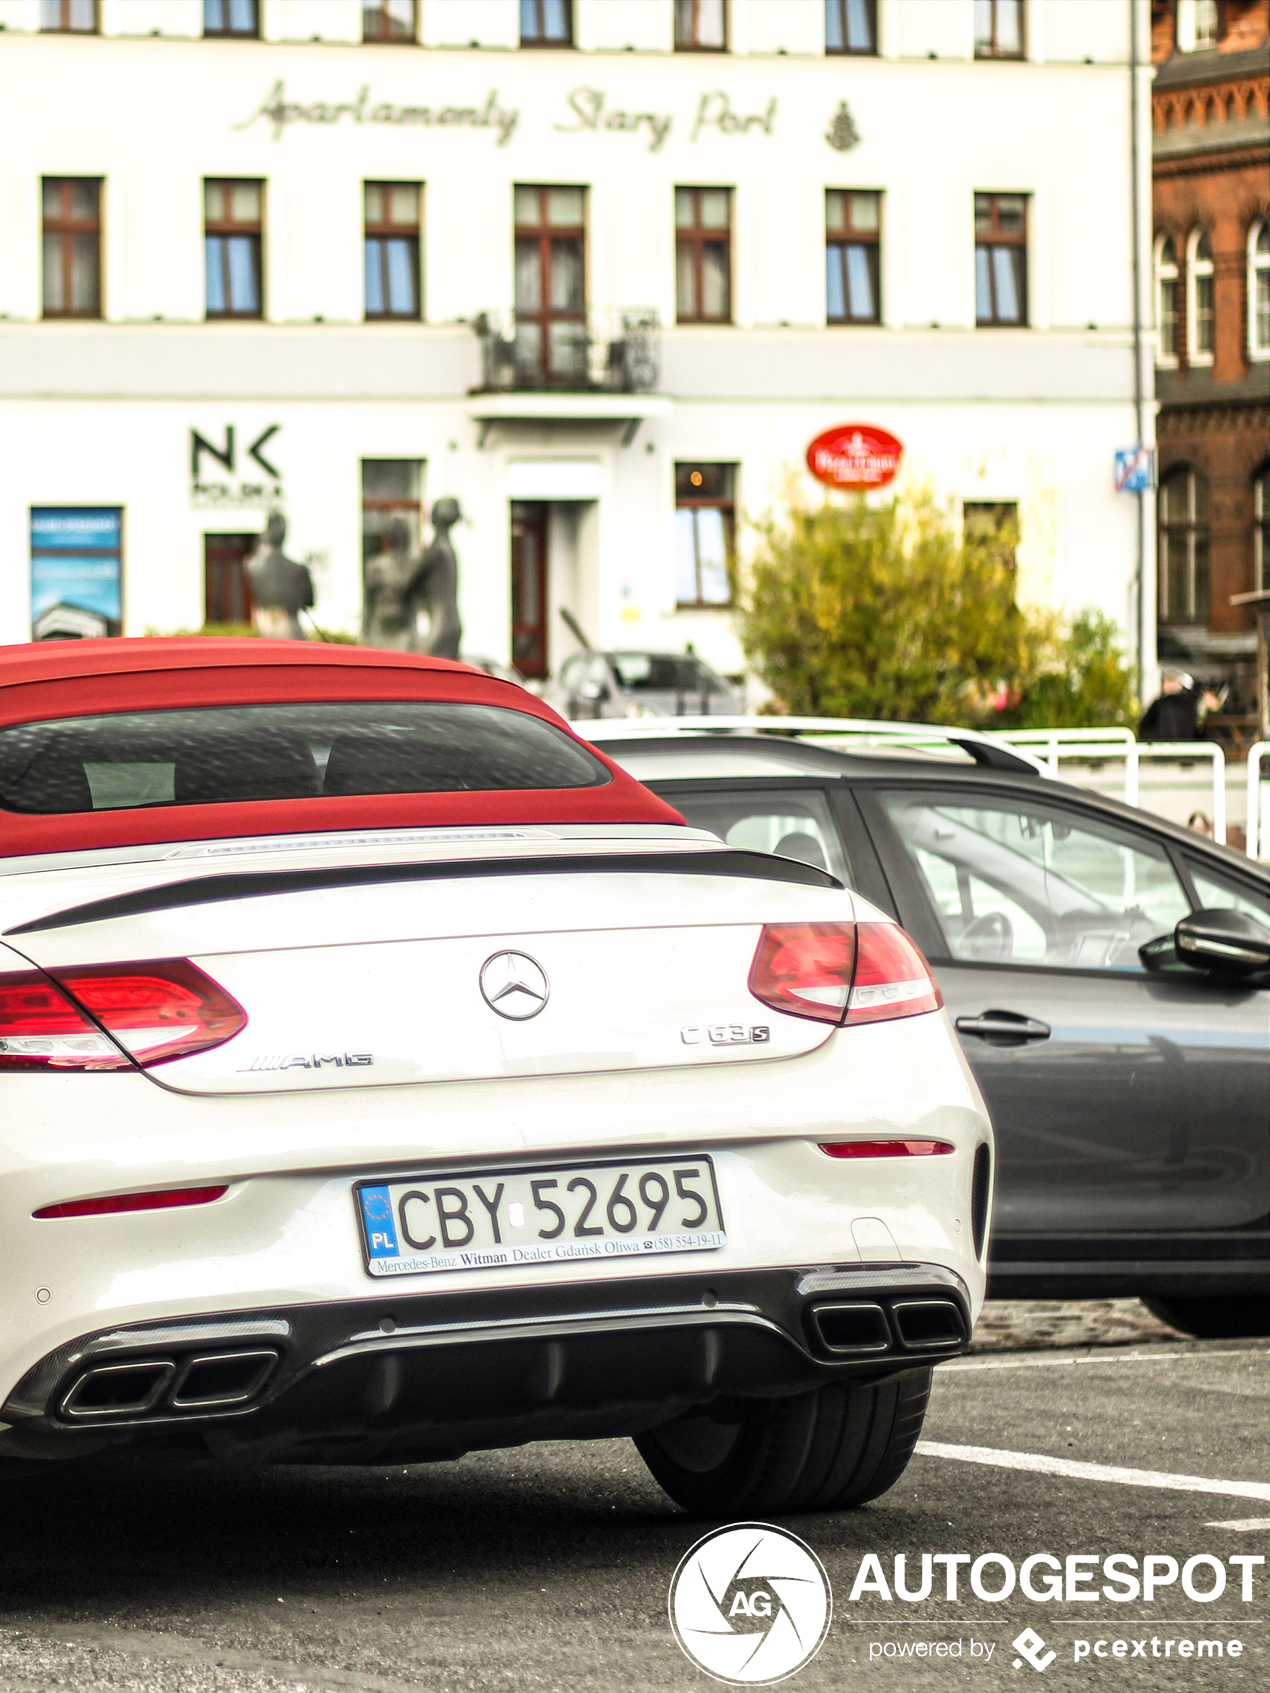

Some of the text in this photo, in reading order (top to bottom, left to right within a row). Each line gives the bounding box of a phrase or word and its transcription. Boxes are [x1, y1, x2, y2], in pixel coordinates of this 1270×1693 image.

[553, 87, 673, 153] Stary
[689, 90, 777, 143] Port
[191, 424, 282, 478] NK
[680, 1026, 701, 1045] C
[398, 1169, 708, 1250] CBY 52695
[371, 1232, 394, 1249] PL
[377, 1256, 457, 1273] Mercedes-Benz
[460, 1252, 508, 1266] Witman
[512, 1246, 552, 1262] Dealer
[555, 1242, 602, 1258] Gdańsk
[604, 1240, 640, 1254] Oliwa
[654, 1236, 673, 1251] (58)
